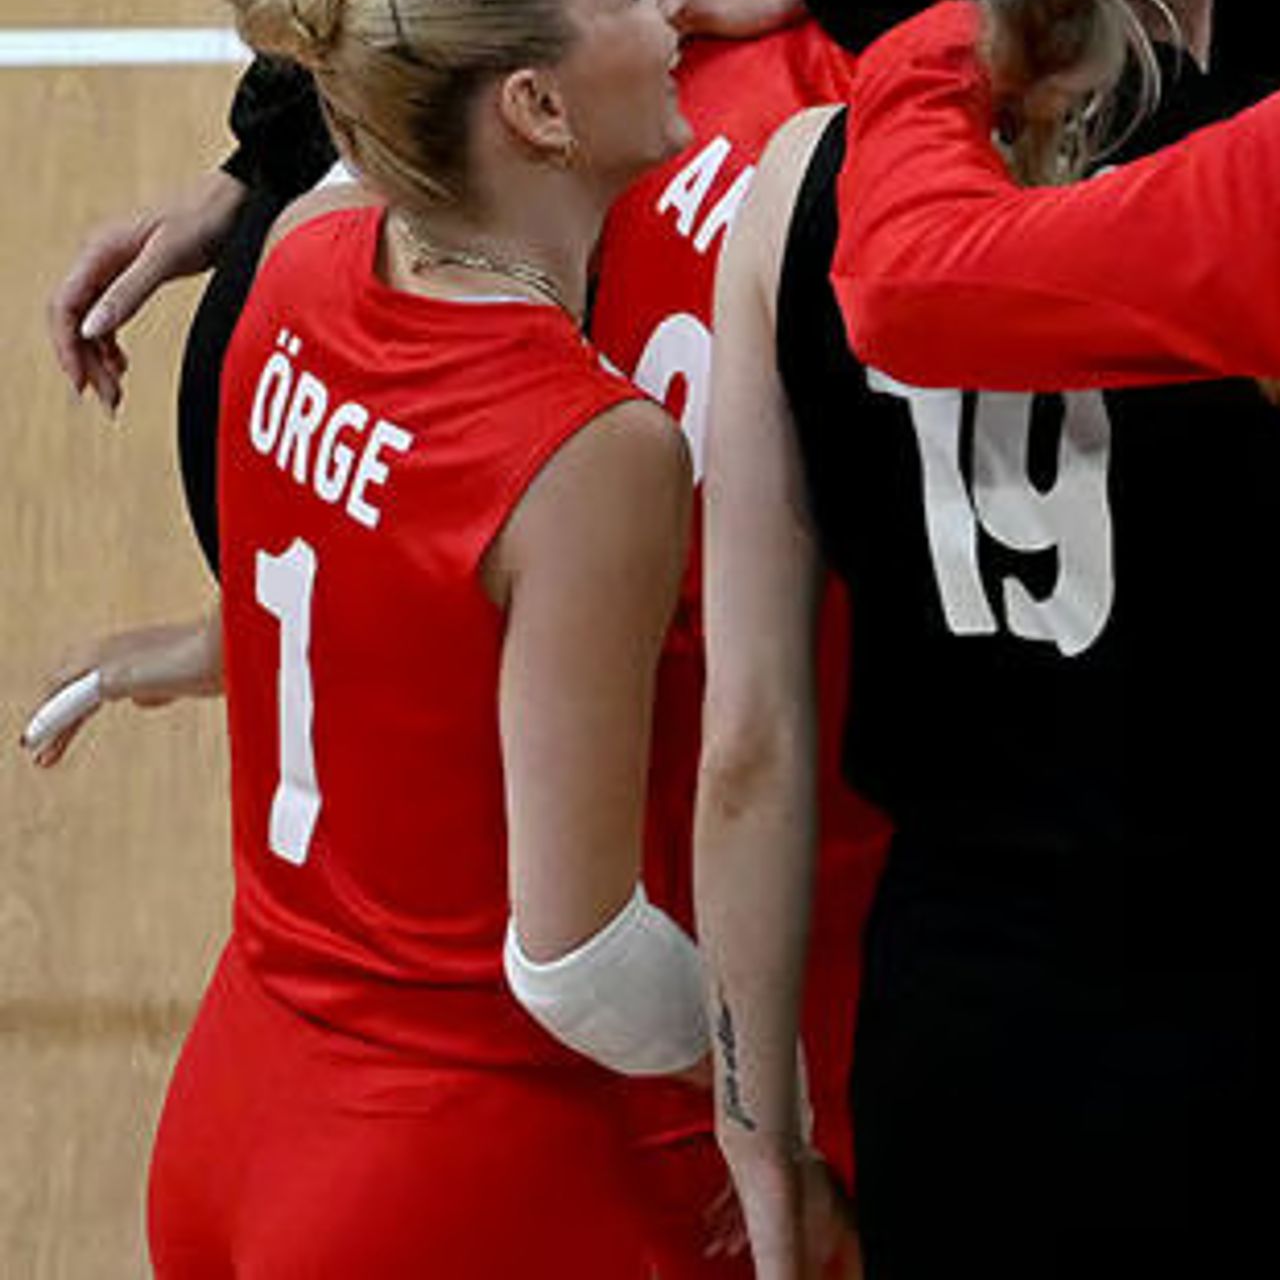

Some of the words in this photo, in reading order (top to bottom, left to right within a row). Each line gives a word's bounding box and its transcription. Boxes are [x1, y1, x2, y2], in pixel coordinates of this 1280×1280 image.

[250, 329, 413, 528] ÖRGE
[865, 366, 1115, 658] 19
[255, 537, 322, 866] 1
